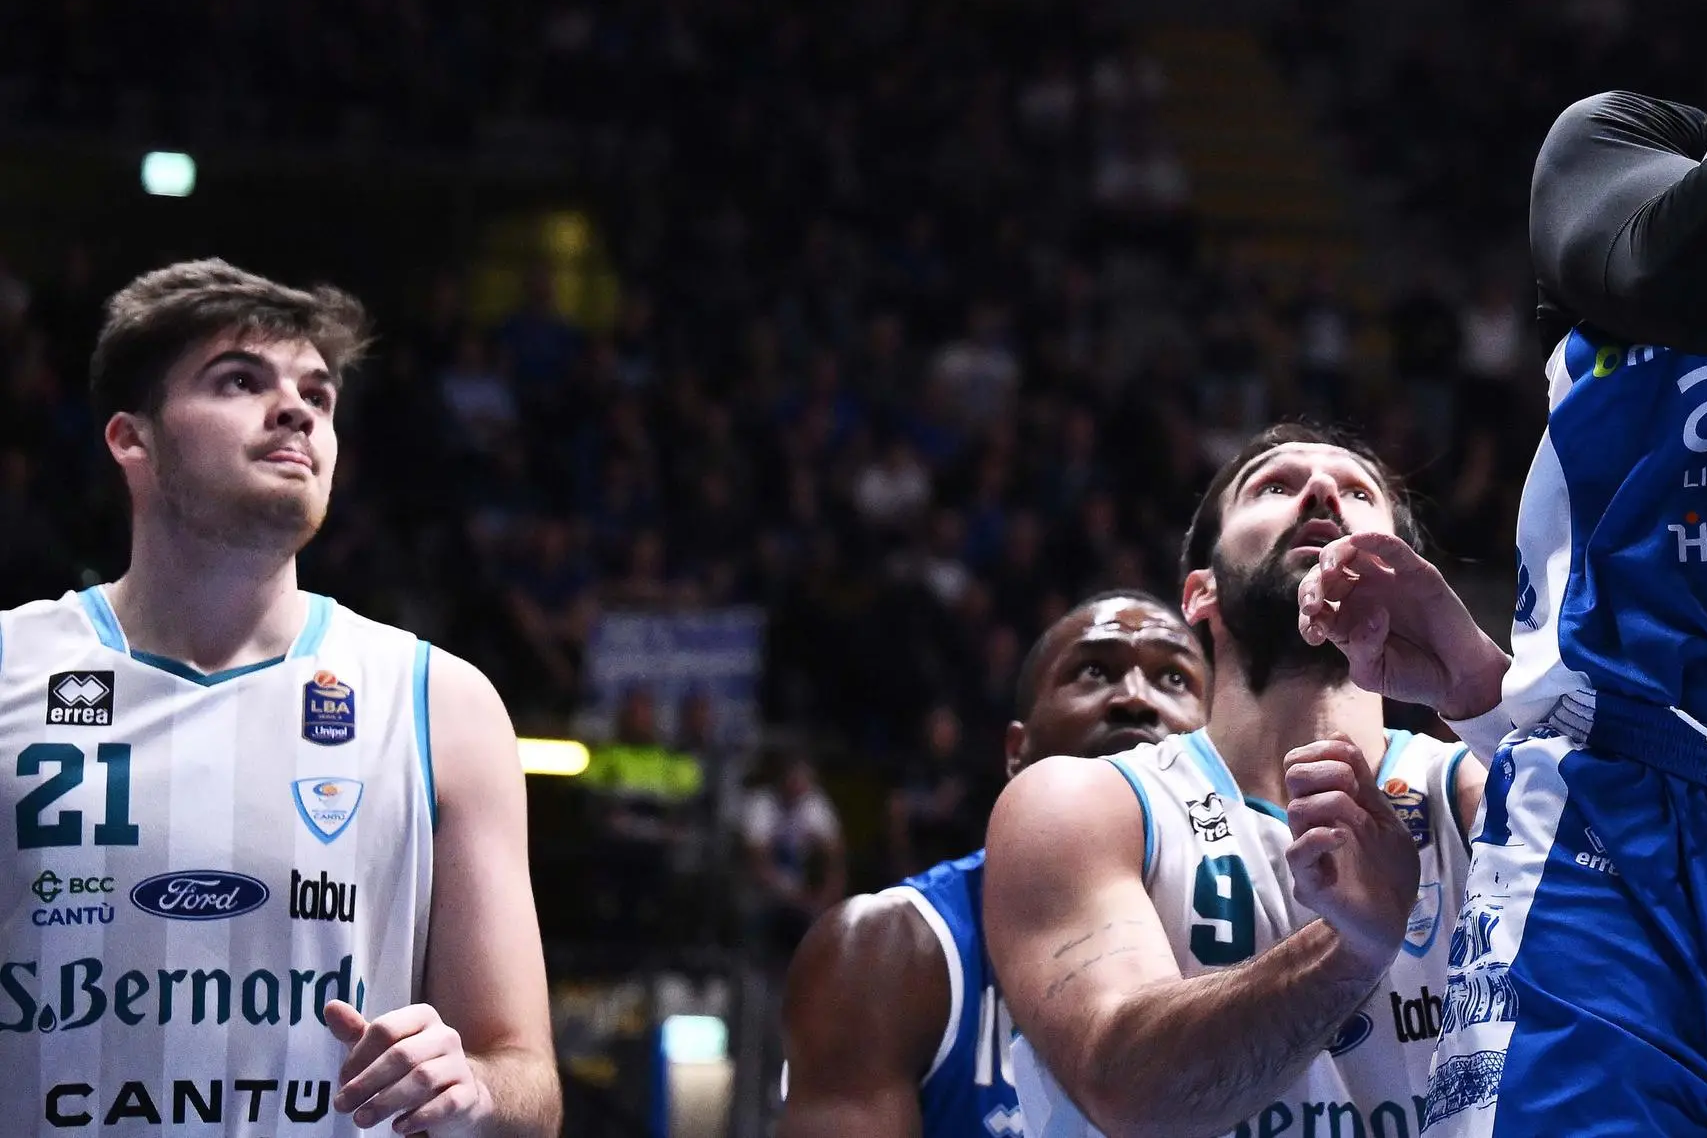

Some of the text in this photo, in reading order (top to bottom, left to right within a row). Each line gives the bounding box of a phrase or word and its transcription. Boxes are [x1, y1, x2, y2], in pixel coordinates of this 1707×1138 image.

[311, 699, 350, 714] LBA
[314, 725, 348, 739] Unipol
[16, 743, 139, 849] 21
[1396, 808, 1424, 821] BA
[69, 877, 115, 894] BCC
[158, 878, 240, 910] Ford
[290, 869, 356, 923] tabu
[32, 903, 115, 927] CANTÙ
[1190, 854, 1255, 966] 9
[0, 954, 366, 1033] S.Bernard
[1390, 986, 1443, 1043] tab
